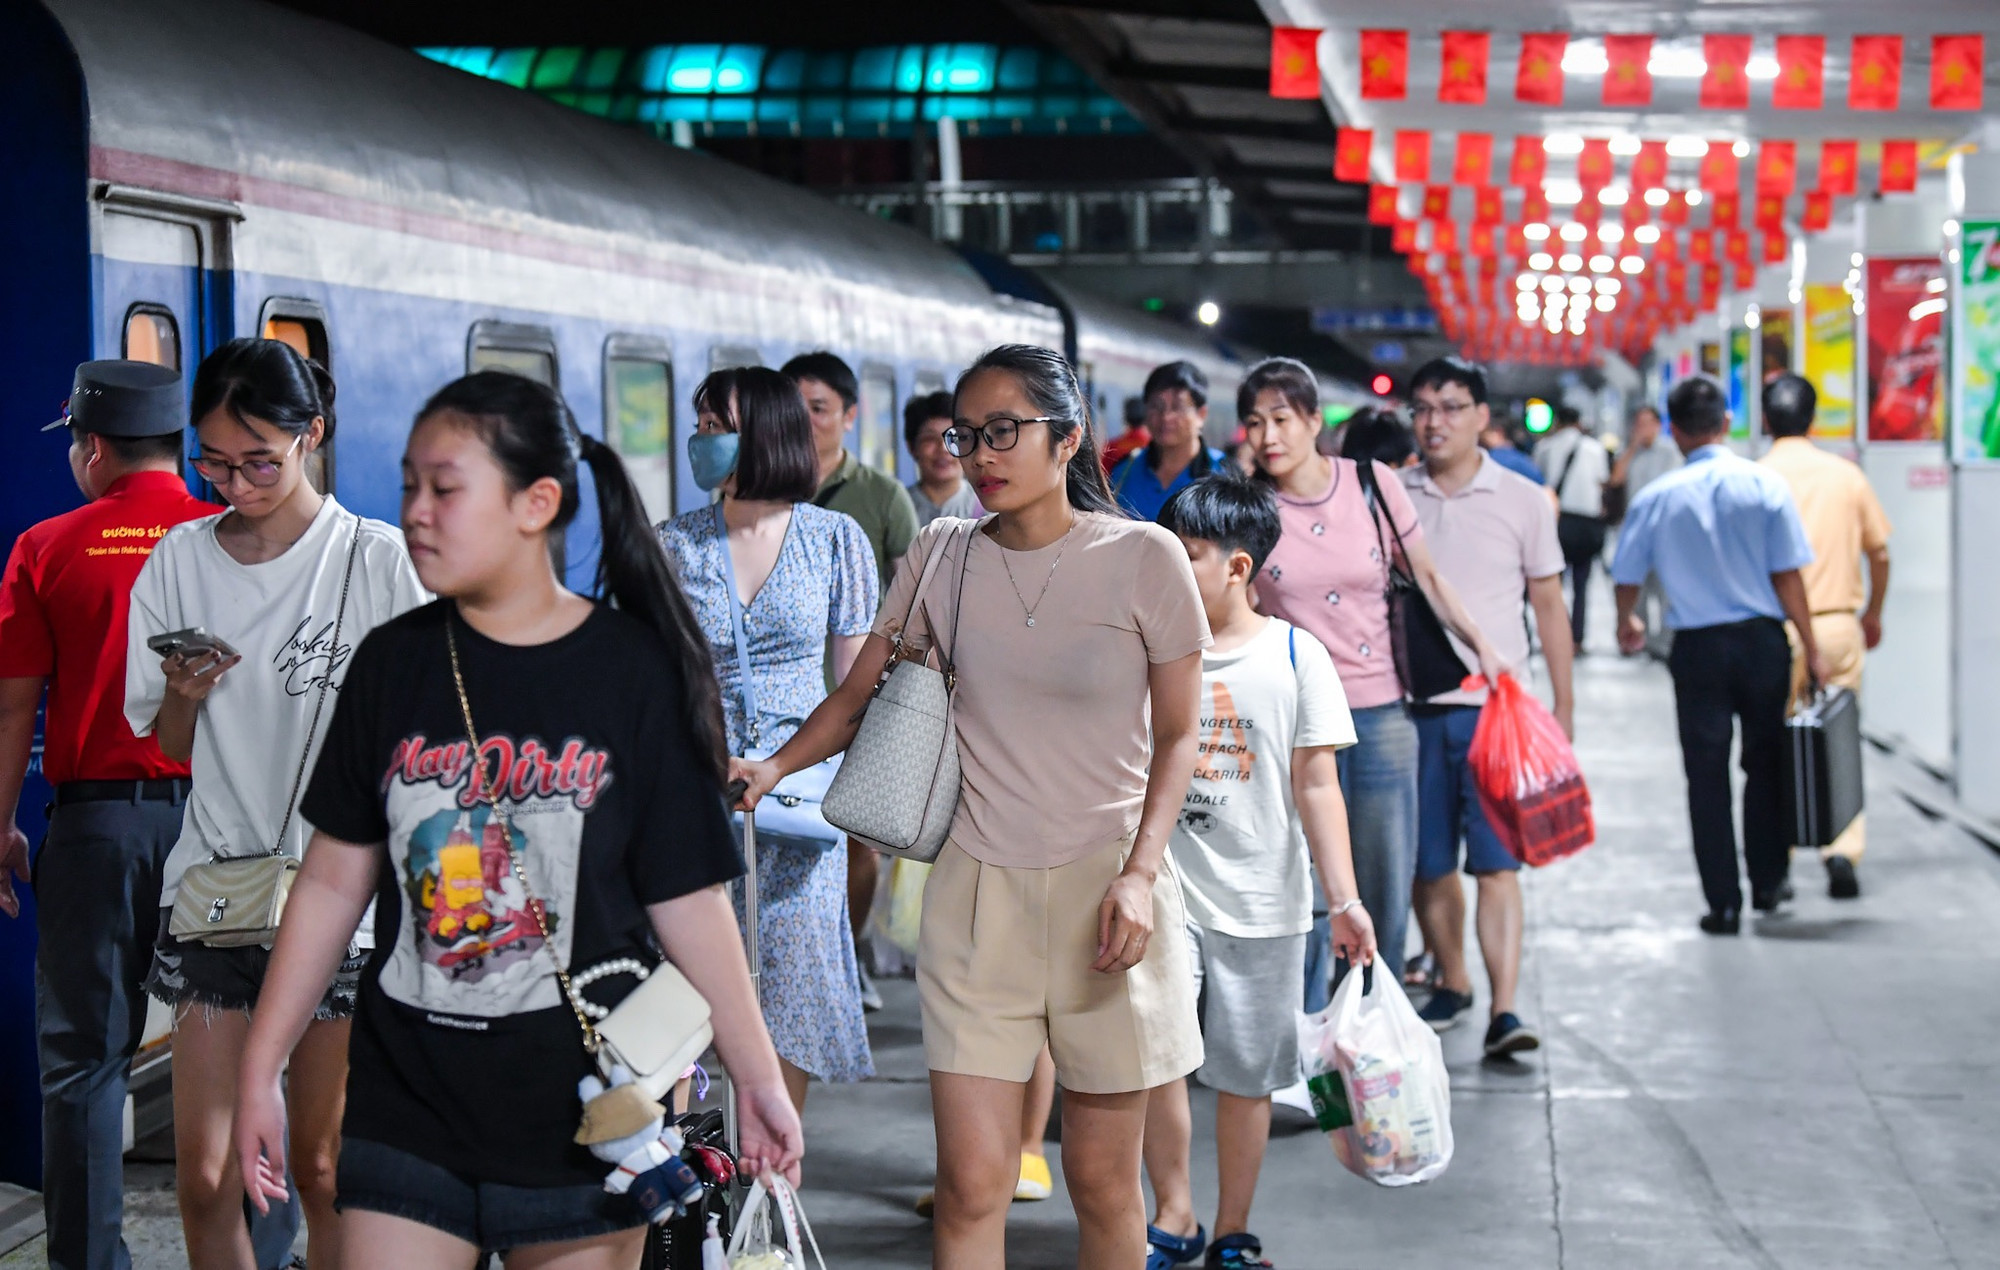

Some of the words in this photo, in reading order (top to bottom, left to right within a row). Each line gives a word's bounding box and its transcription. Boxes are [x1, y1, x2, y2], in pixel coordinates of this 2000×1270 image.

[1199, 717, 1254, 730] NGELES
[1198, 742, 1248, 755] BEACH
[381, 736, 471, 792] Play
[459, 735, 612, 809] Dirty
[1192, 767, 1251, 782] CLARITA
[1184, 792, 1229, 806] NDALE
